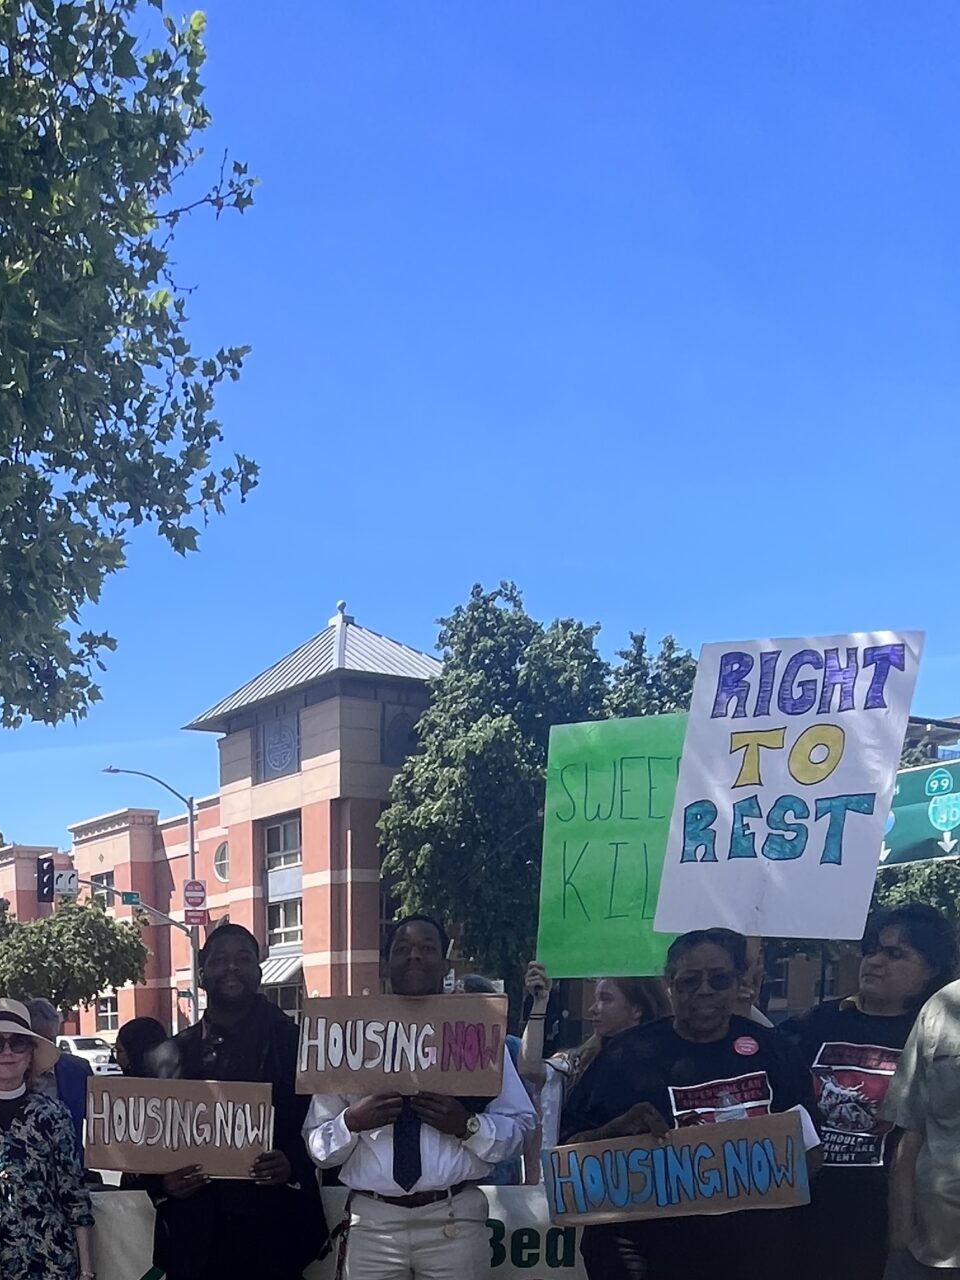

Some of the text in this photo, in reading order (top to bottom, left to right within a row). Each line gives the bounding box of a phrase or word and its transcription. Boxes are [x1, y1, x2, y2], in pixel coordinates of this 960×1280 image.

[710, 644, 905, 718] RIGHT
[556, 756, 681, 822] SWEE
[730, 723, 846, 789] TO
[930, 778, 949, 792] 99
[680, 793, 876, 865] REST
[300, 1015, 500, 1072] HOUSING NOW
[87, 1090, 265, 1150] HOUSING NOW
[552, 1135, 794, 1214] HOUSING NOW
